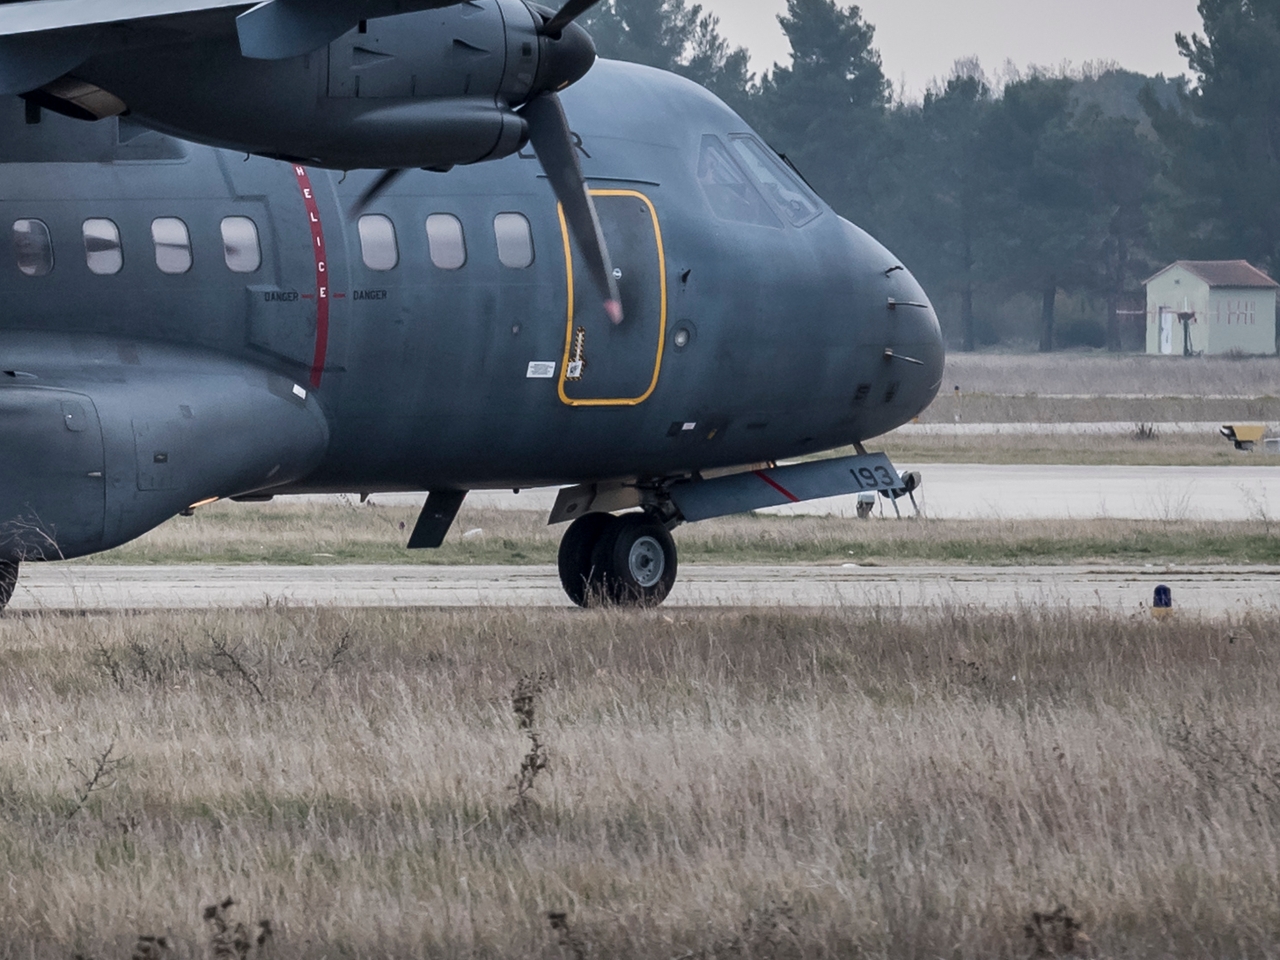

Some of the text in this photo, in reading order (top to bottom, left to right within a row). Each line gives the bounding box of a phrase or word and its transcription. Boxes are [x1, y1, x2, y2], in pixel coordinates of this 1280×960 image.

[295, 166, 326, 298] HELICE
[264, 292, 299, 302] DANGER
[353, 290, 387, 300] DANGER
[850, 466, 894, 489] 193
